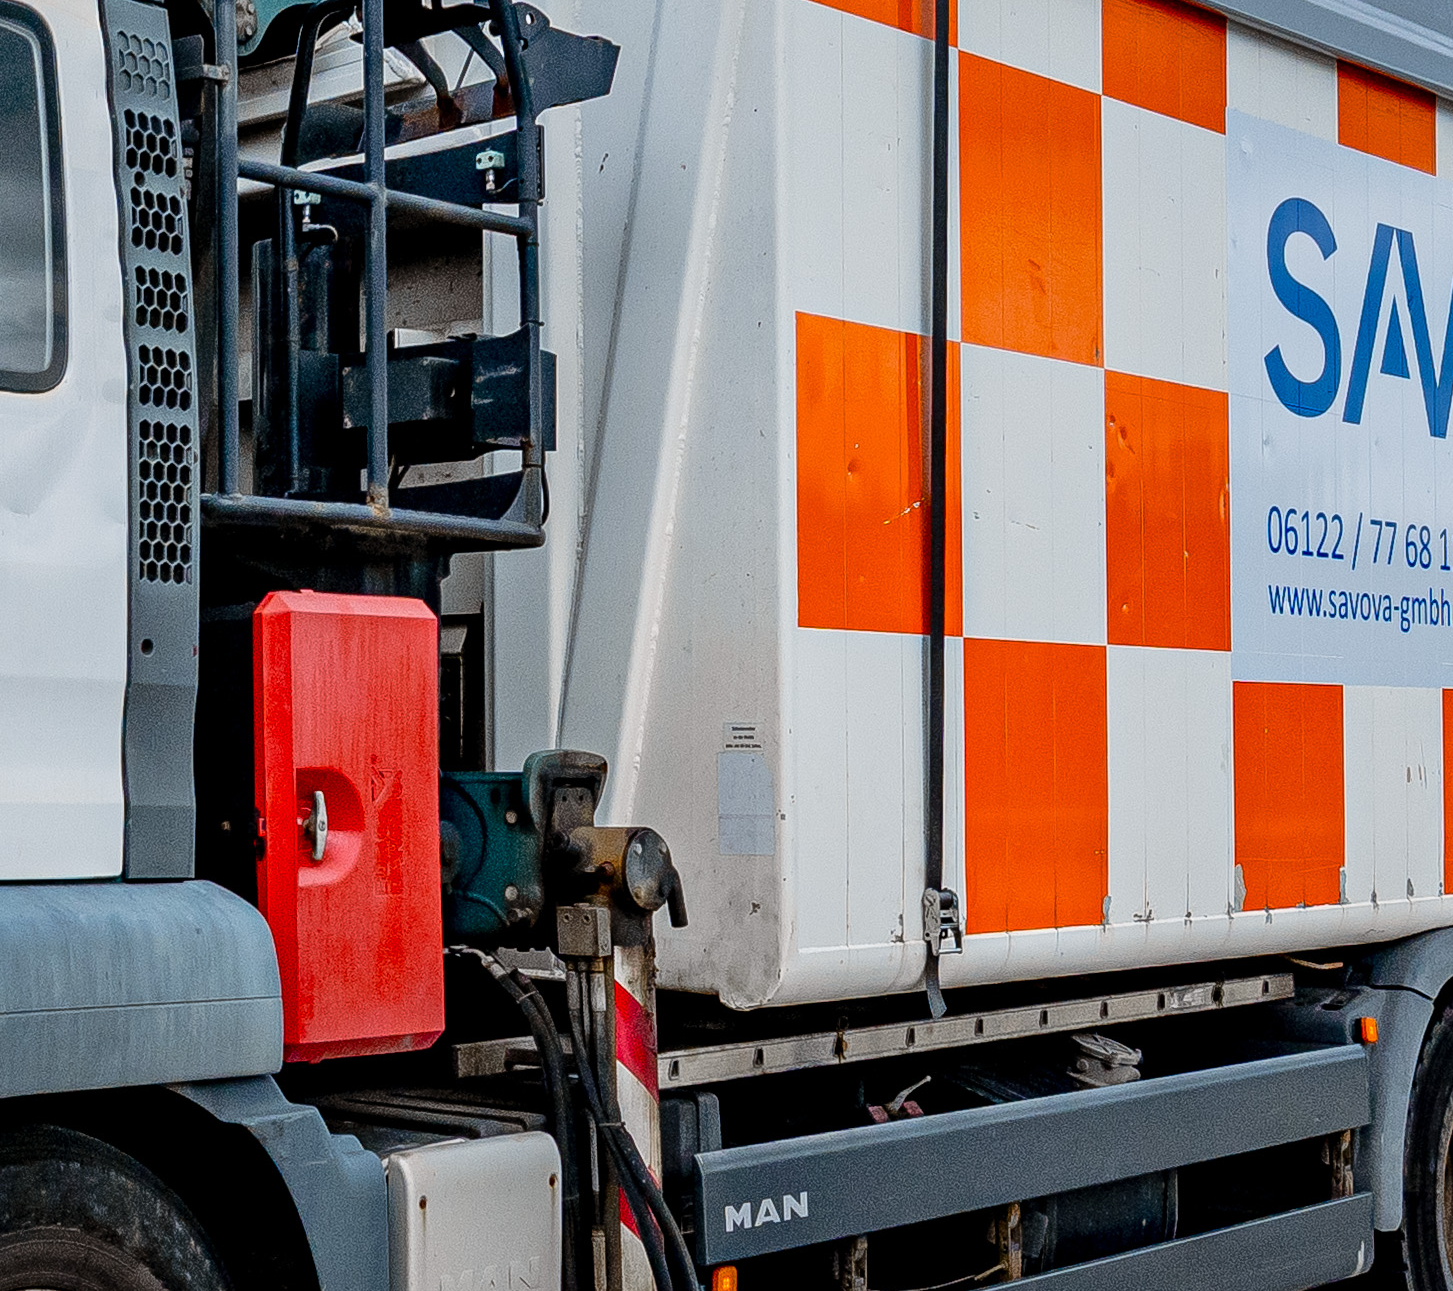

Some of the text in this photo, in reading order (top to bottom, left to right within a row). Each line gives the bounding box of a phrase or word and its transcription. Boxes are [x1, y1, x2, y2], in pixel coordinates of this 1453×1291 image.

[1267, 505, 1345, 561] 06122
[1351, 512, 1364, 571] /
[1369, 518, 1398, 566] 77
[1405, 523, 1432, 570] 68
[724, 1191, 809, 1232] MAN
